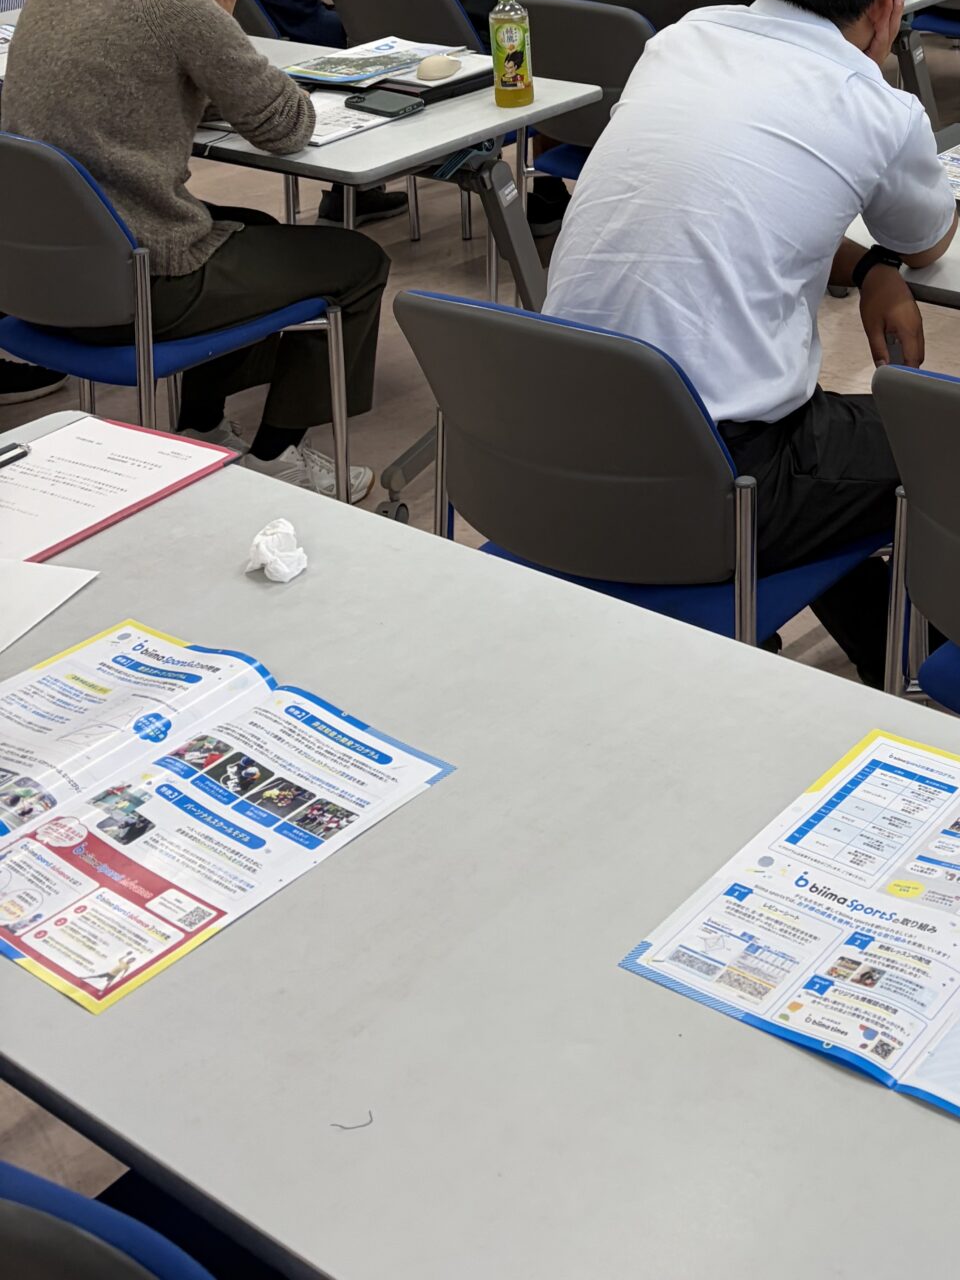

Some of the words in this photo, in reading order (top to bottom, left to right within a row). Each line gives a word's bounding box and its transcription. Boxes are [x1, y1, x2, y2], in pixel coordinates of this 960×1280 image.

[182, 801, 253, 843] パーソナルスクールモデル
[806, 881, 851, 905] biima
[760, 901, 802, 921] レビューシート
[810, 1017, 833, 1030] biima
[828, 1024, 850, 1037] times
